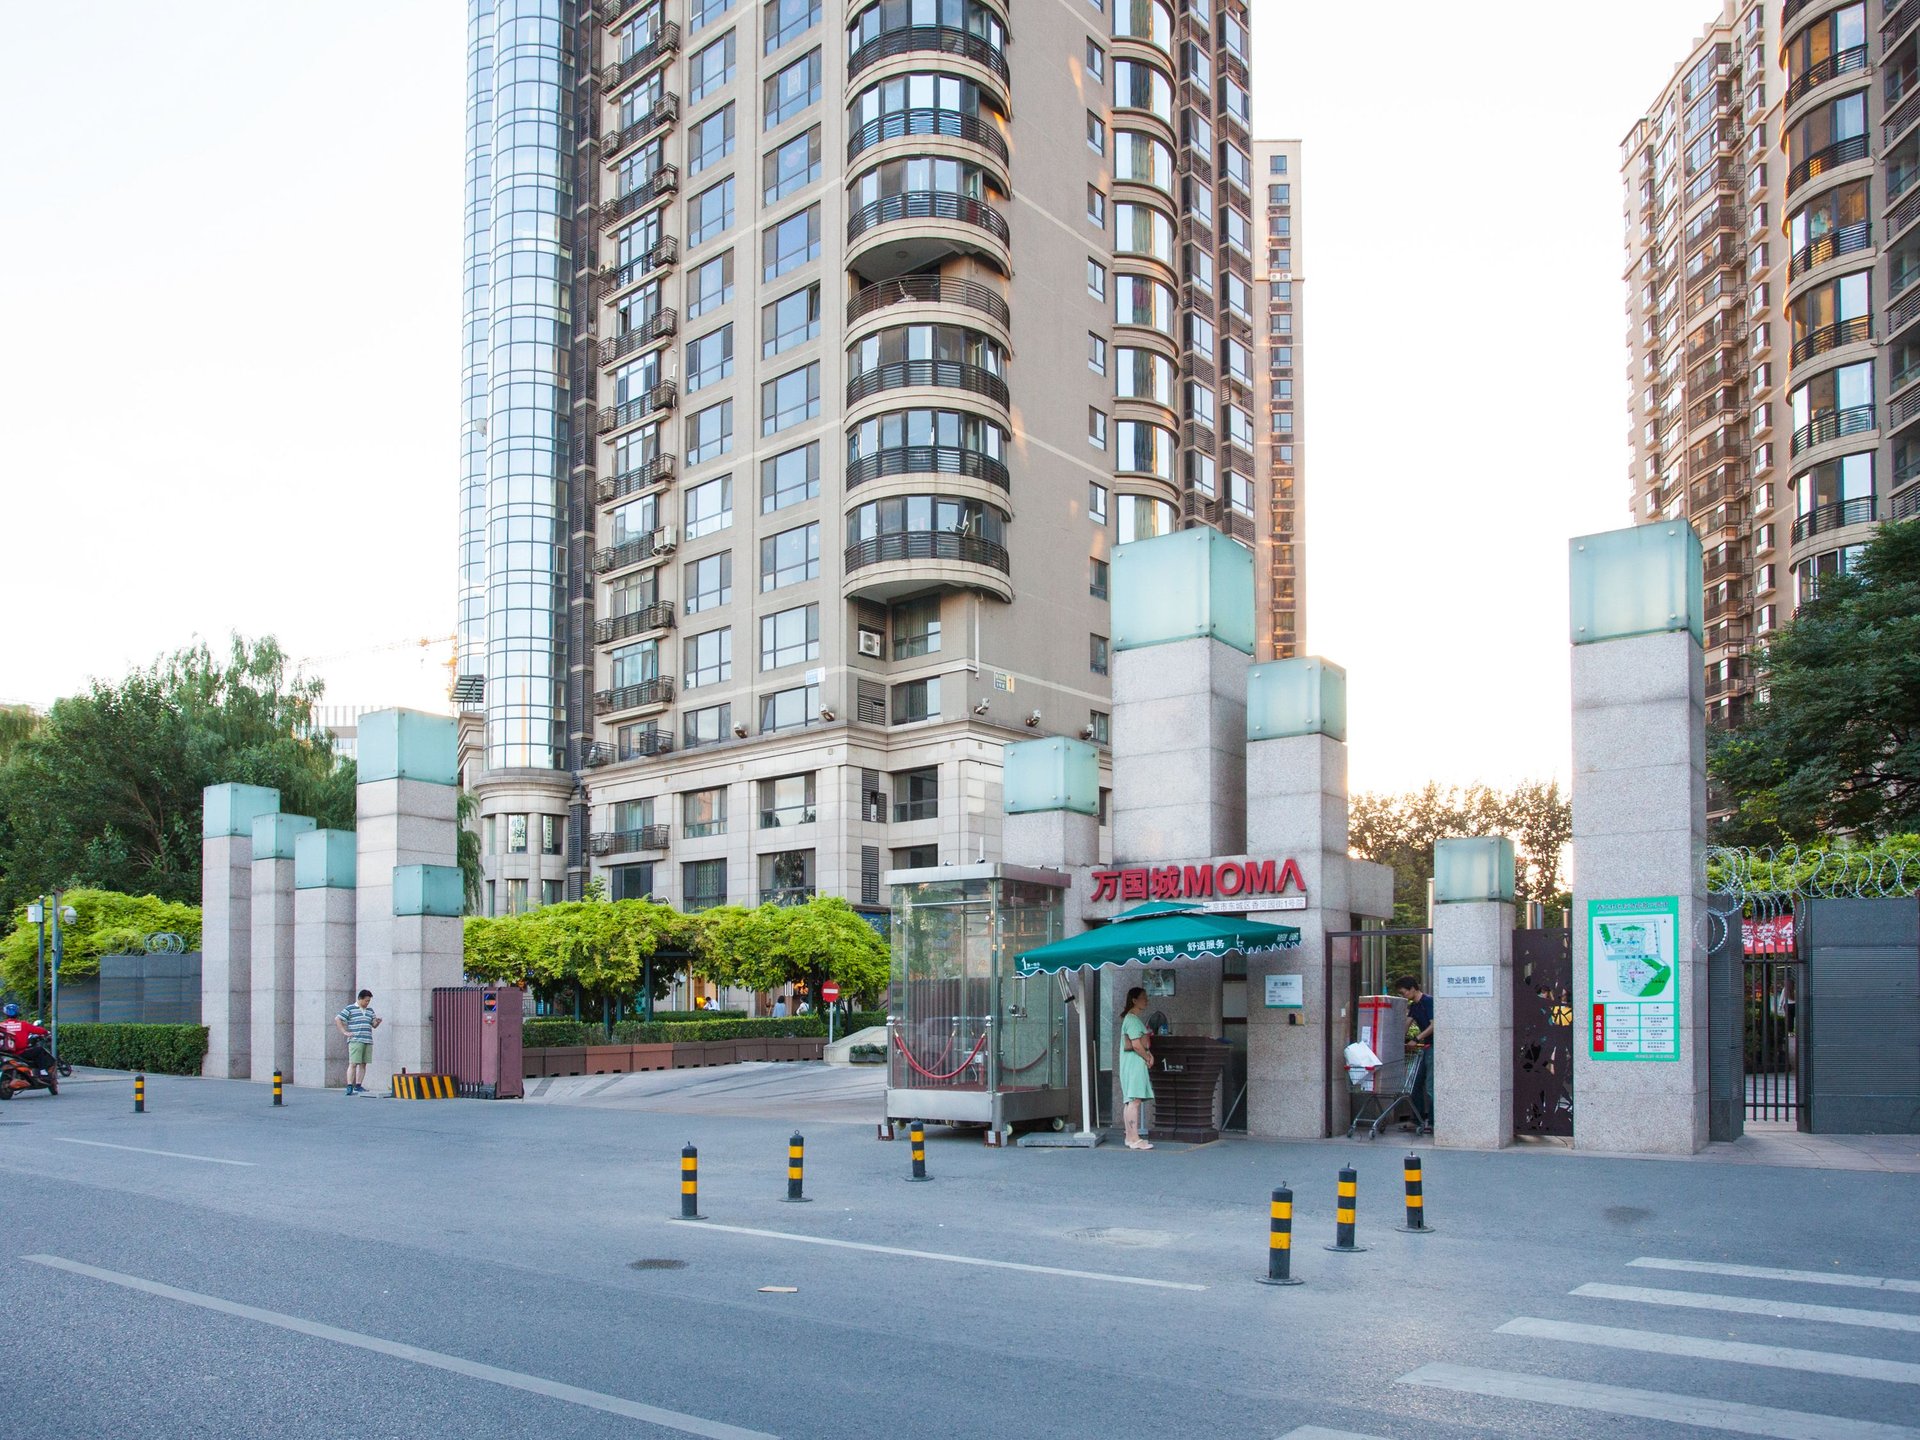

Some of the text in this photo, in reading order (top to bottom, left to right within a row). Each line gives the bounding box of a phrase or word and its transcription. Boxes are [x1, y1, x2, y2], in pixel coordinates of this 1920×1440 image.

[1137, 944, 1174, 957] 科技设施
[1187, 939, 1225, 952] 舒适服务
